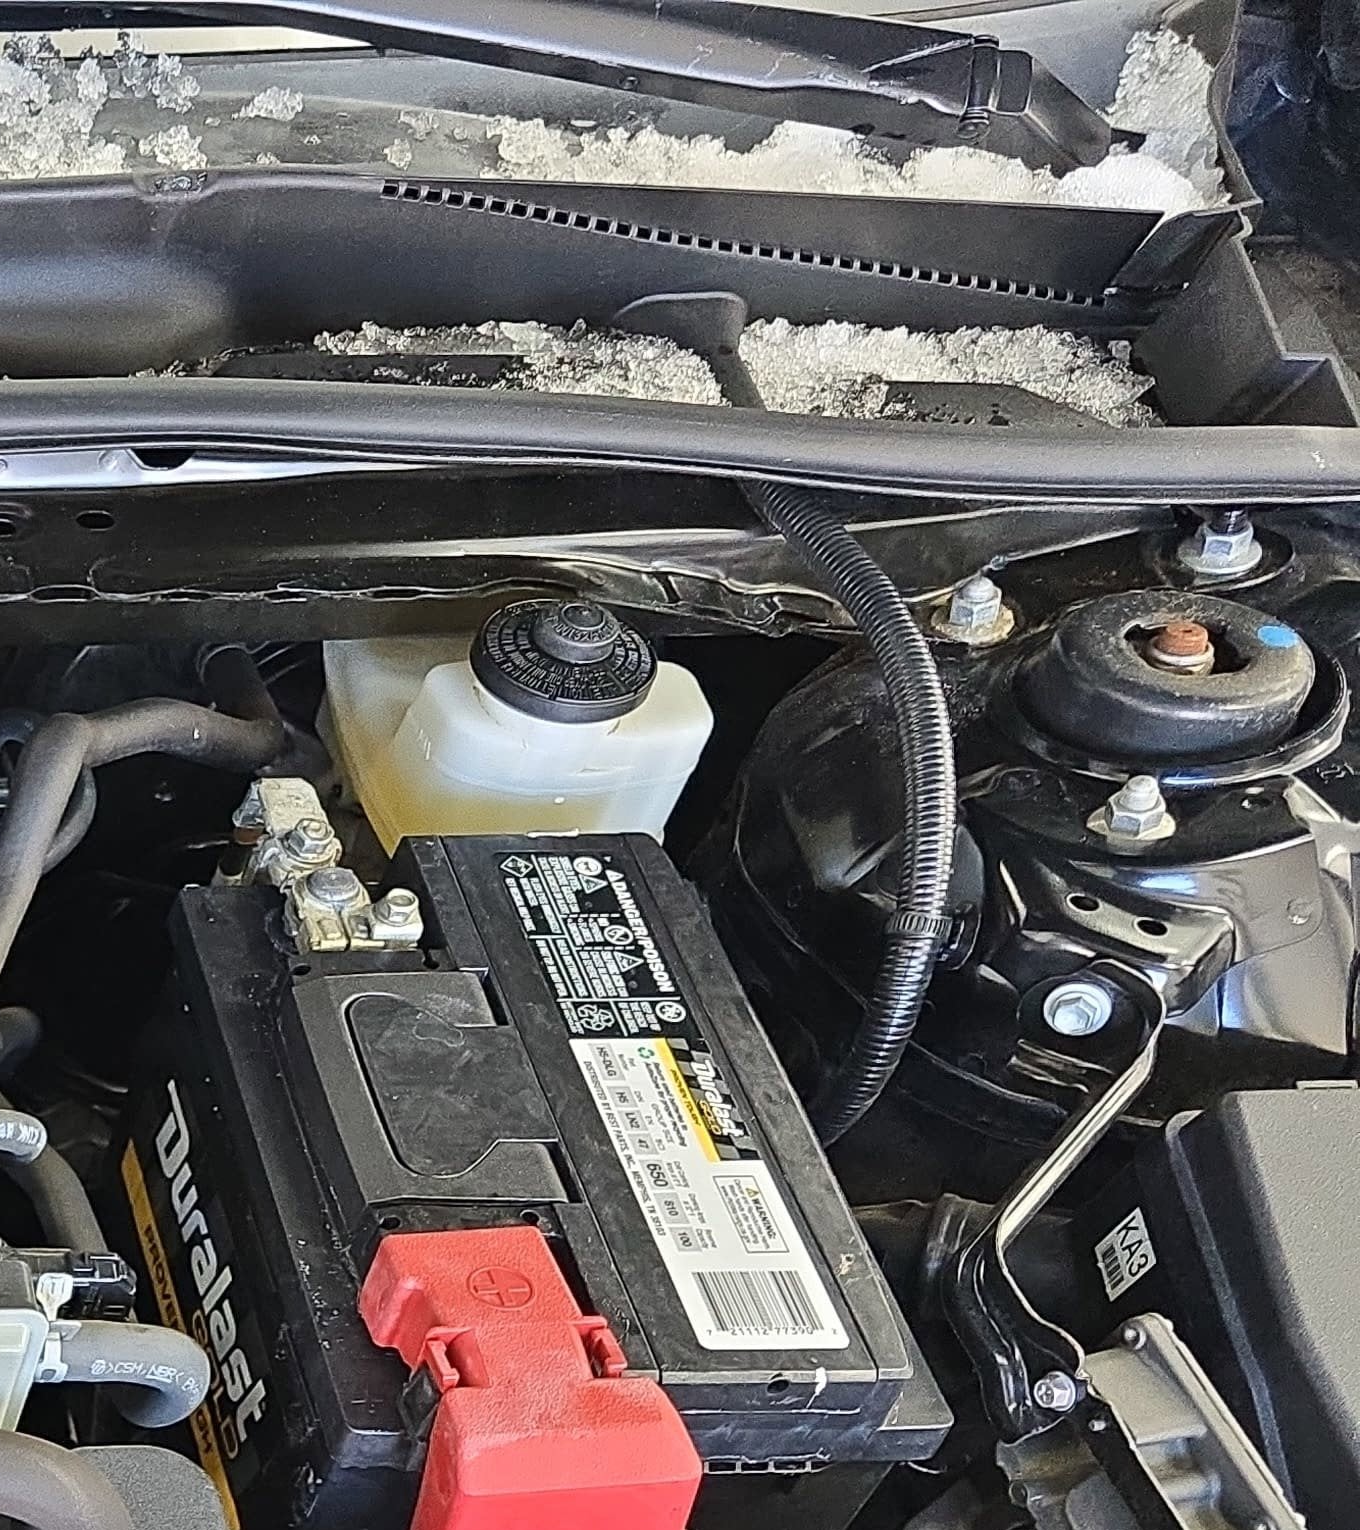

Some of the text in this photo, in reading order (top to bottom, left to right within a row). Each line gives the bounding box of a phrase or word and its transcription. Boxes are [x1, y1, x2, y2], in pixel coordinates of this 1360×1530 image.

[610, 881, 675, 992] DANGER/POISON
[688, 1059, 746, 1136] Duralast
[624, 1111, 641, 1128] LN2
[698, 1100, 722, 1135] GOLD
[635, 1138, 650, 1148] 47
[645, 1163, 669, 1187] 650
[676, 1231, 693, 1247] 100
[1116, 1215, 1151, 1277] KA3
[157, 1079, 264, 1442] Duralast
